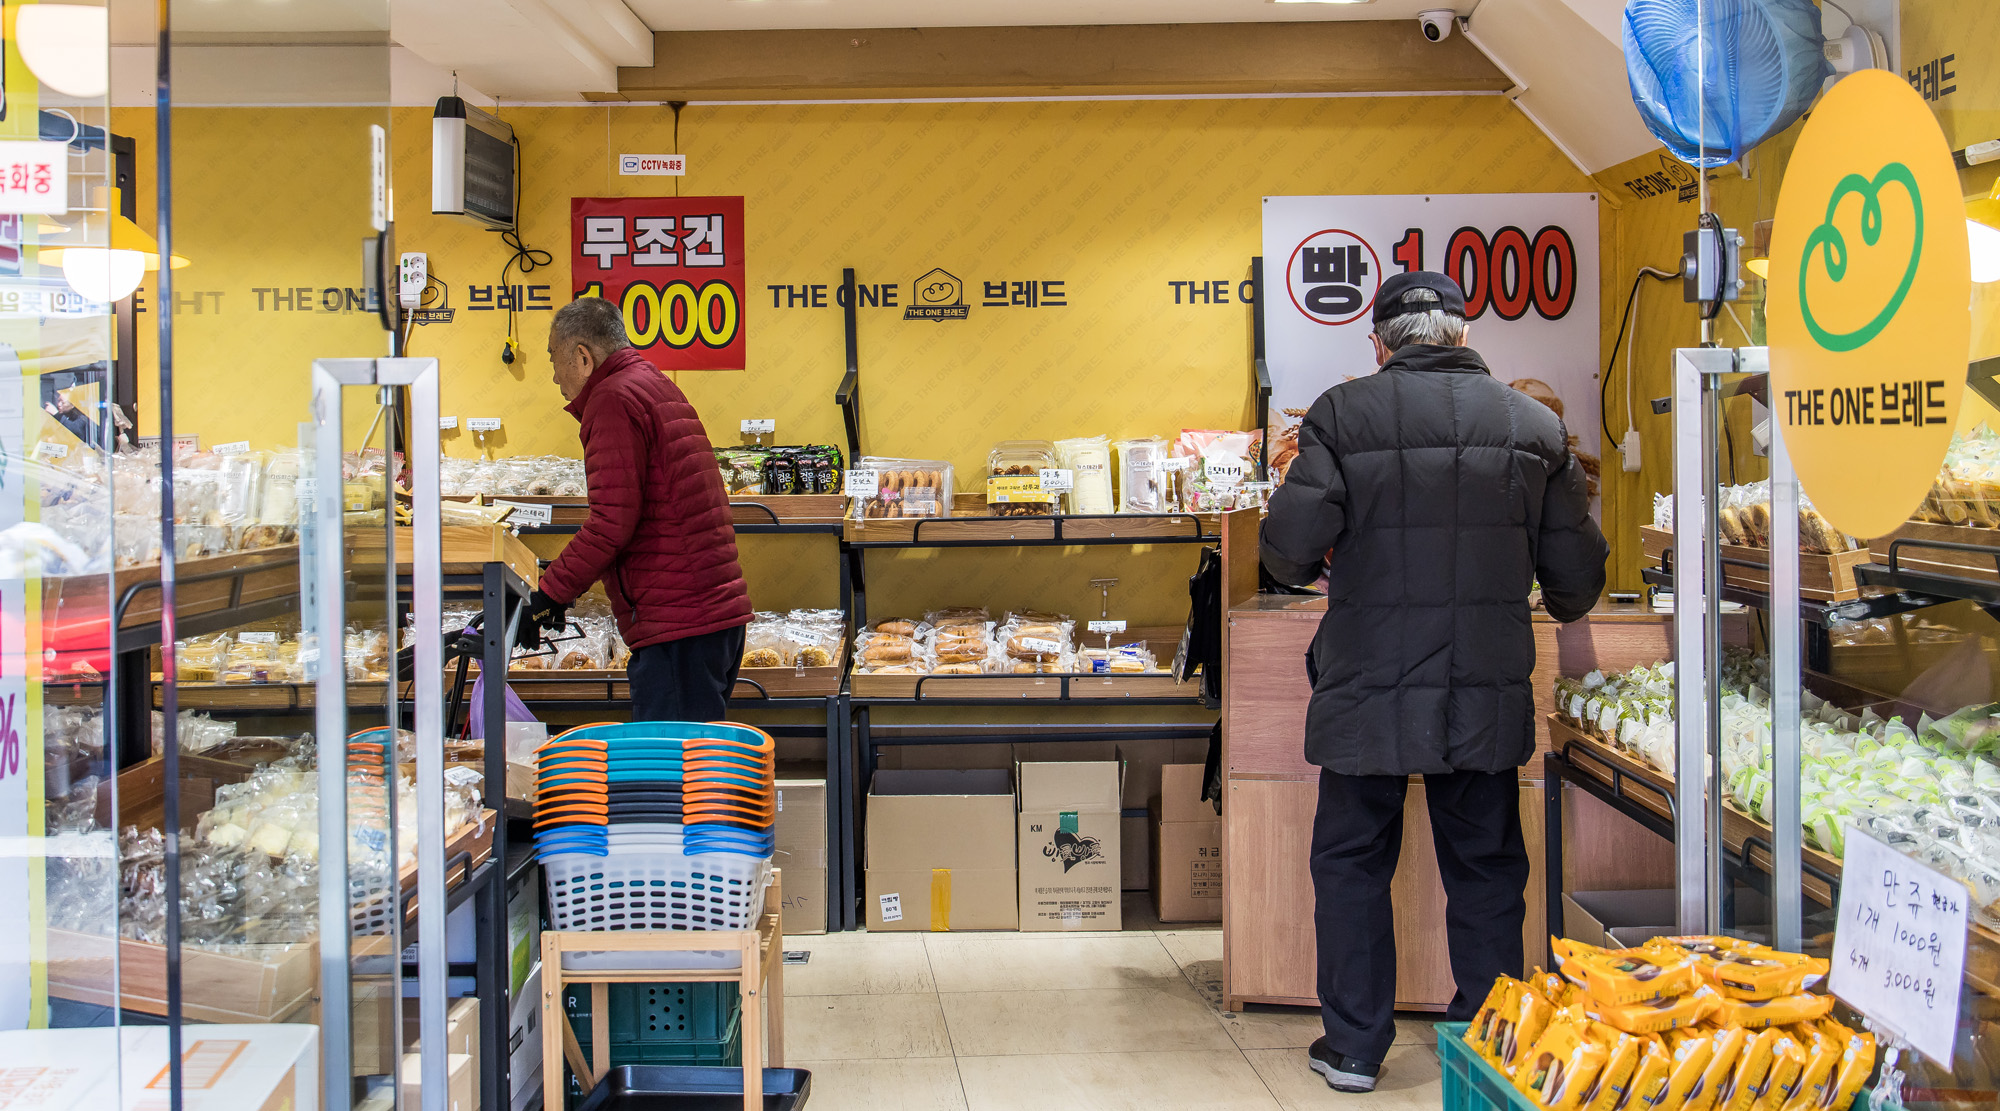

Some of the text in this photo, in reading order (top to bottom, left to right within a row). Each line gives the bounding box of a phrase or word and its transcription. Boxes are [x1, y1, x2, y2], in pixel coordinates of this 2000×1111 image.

[581, 214, 726, 270] 무조건
[1168, 281, 1230, 305] THE
[1302, 245, 1368, 315] 빵
[252, 288, 313, 311] THE
[468, 285, 553, 312] 브레드
[767, 284, 828, 308] THE
[982, 281, 1067, 308] 브레드
[908, 309, 924, 317] THE
[943, 308, 966, 317] 브레드
[1784, 380, 1947, 427] THE ONE 브레드
[1213, 466, 1241, 476] 모나카
[1030, 824, 1043, 833] KM
[1884, 869, 1923, 920] 만쥬
[1856, 903, 1942, 968] 1개 1000원
[1849, 948, 1870, 972] 4개
